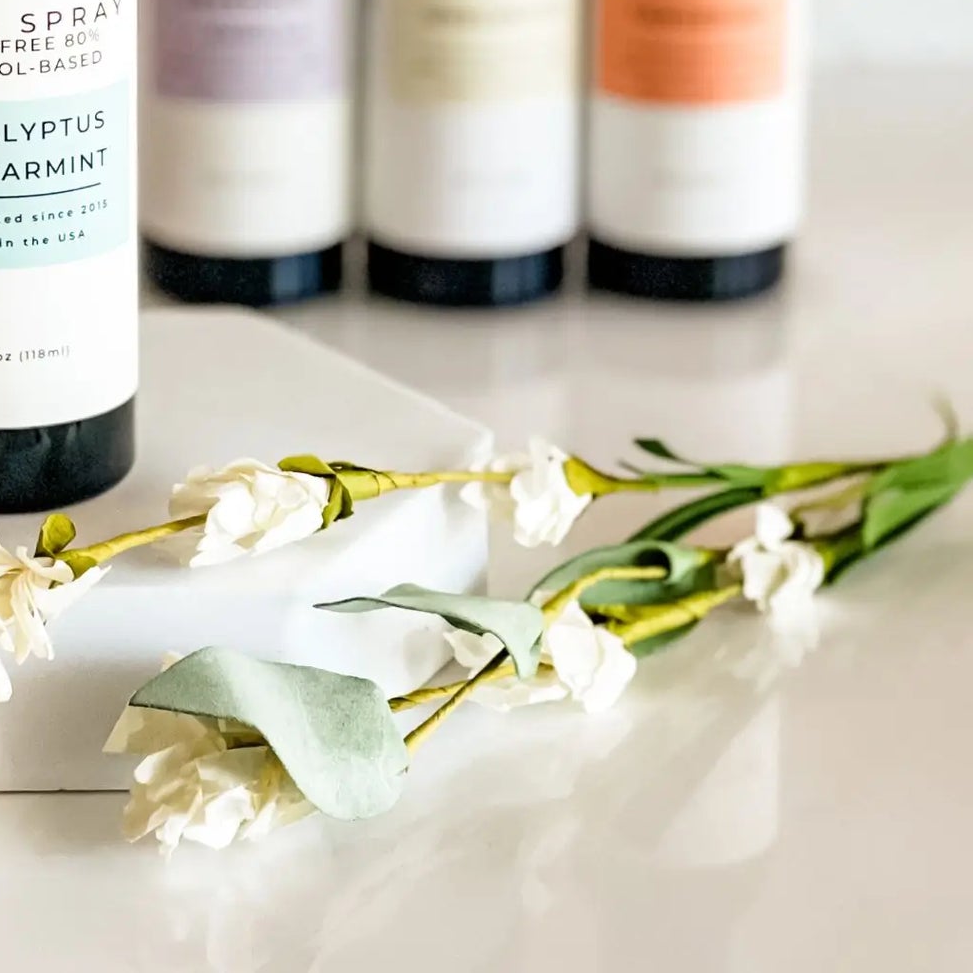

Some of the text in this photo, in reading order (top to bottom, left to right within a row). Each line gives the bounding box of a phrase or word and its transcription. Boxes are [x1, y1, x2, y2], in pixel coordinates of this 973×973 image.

[64, 28, 100, 48] 80%
[32, 208, 74, 222] since
[80, 199, 109, 215] 2015
[0, 237, 14, 248] in
[23, 235, 49, 246] the
[58, 229, 85, 243] USA
[19, 345, 71, 363] (118ml)
